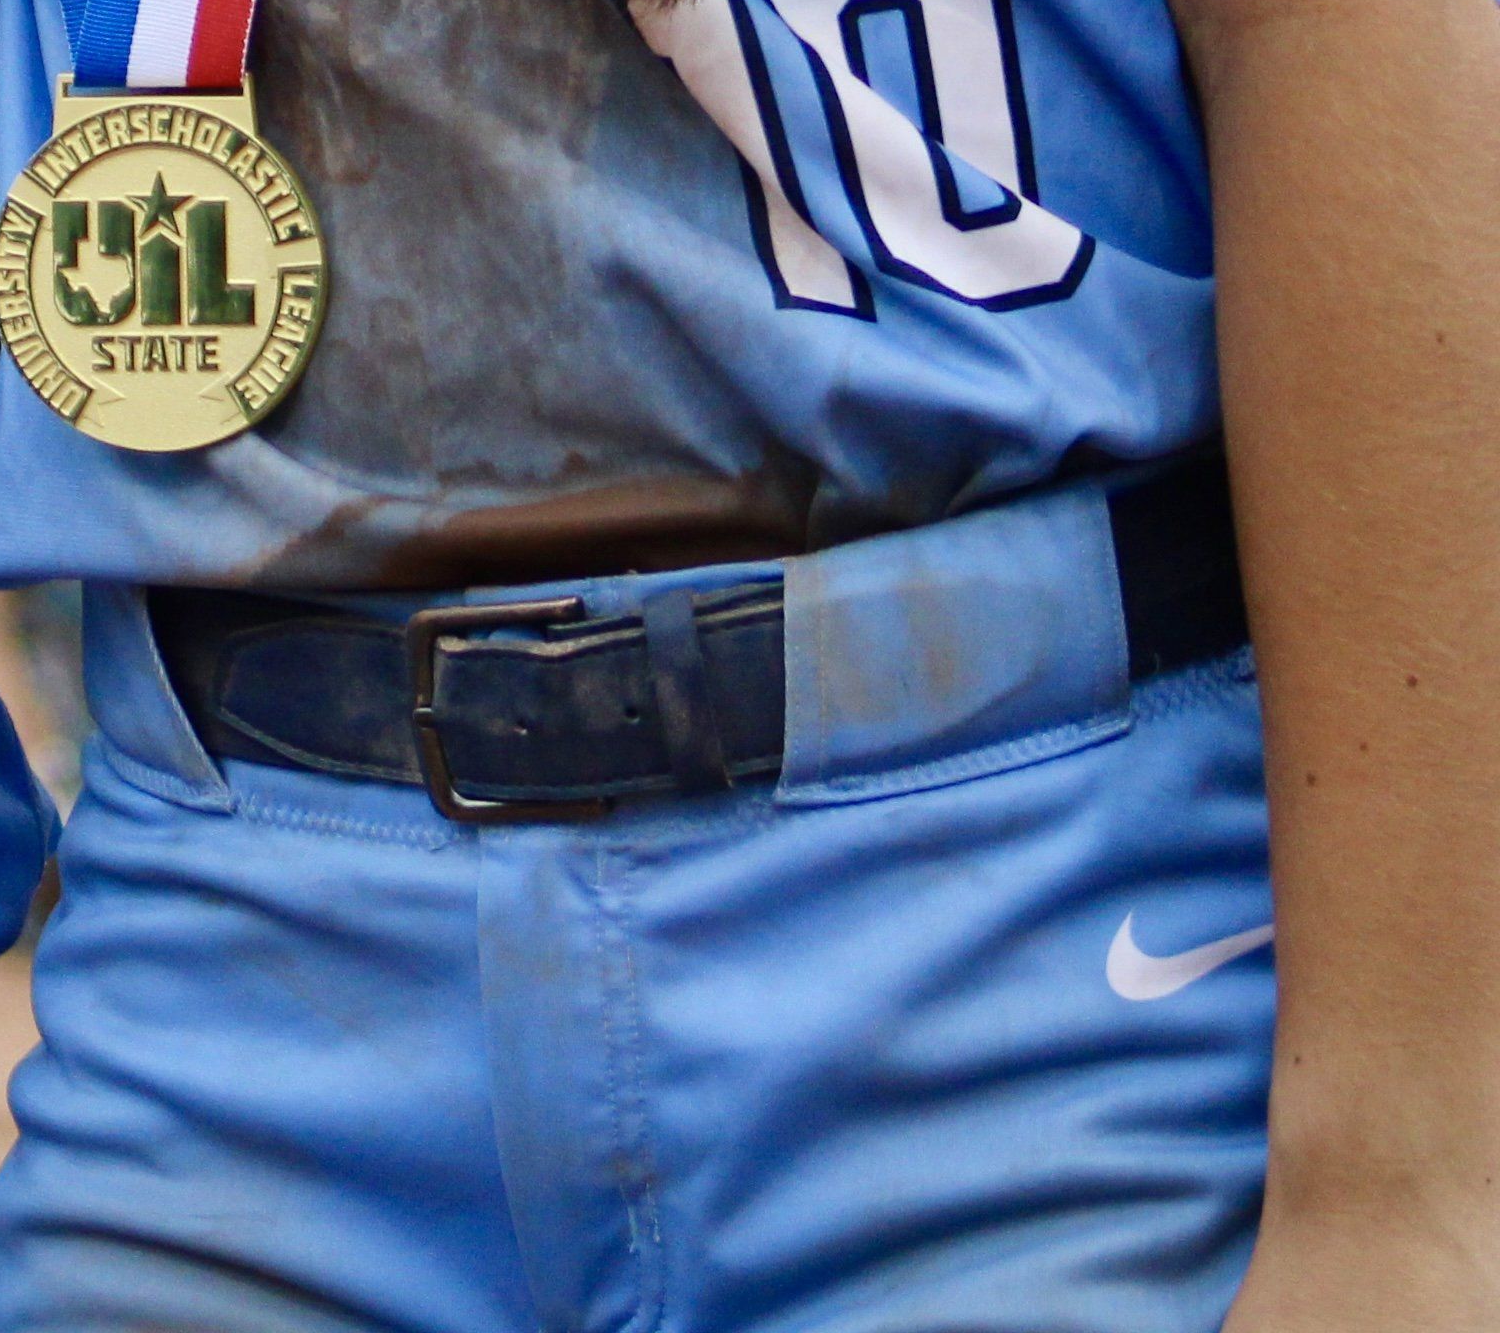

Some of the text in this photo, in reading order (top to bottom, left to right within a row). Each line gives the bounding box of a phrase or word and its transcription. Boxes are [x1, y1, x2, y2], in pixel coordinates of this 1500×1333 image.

[34, 107, 310, 241] INTERSCHOLASTIC
[233, 272, 317, 409] LEAGUE
[92, 335, 219, 372] STATE
